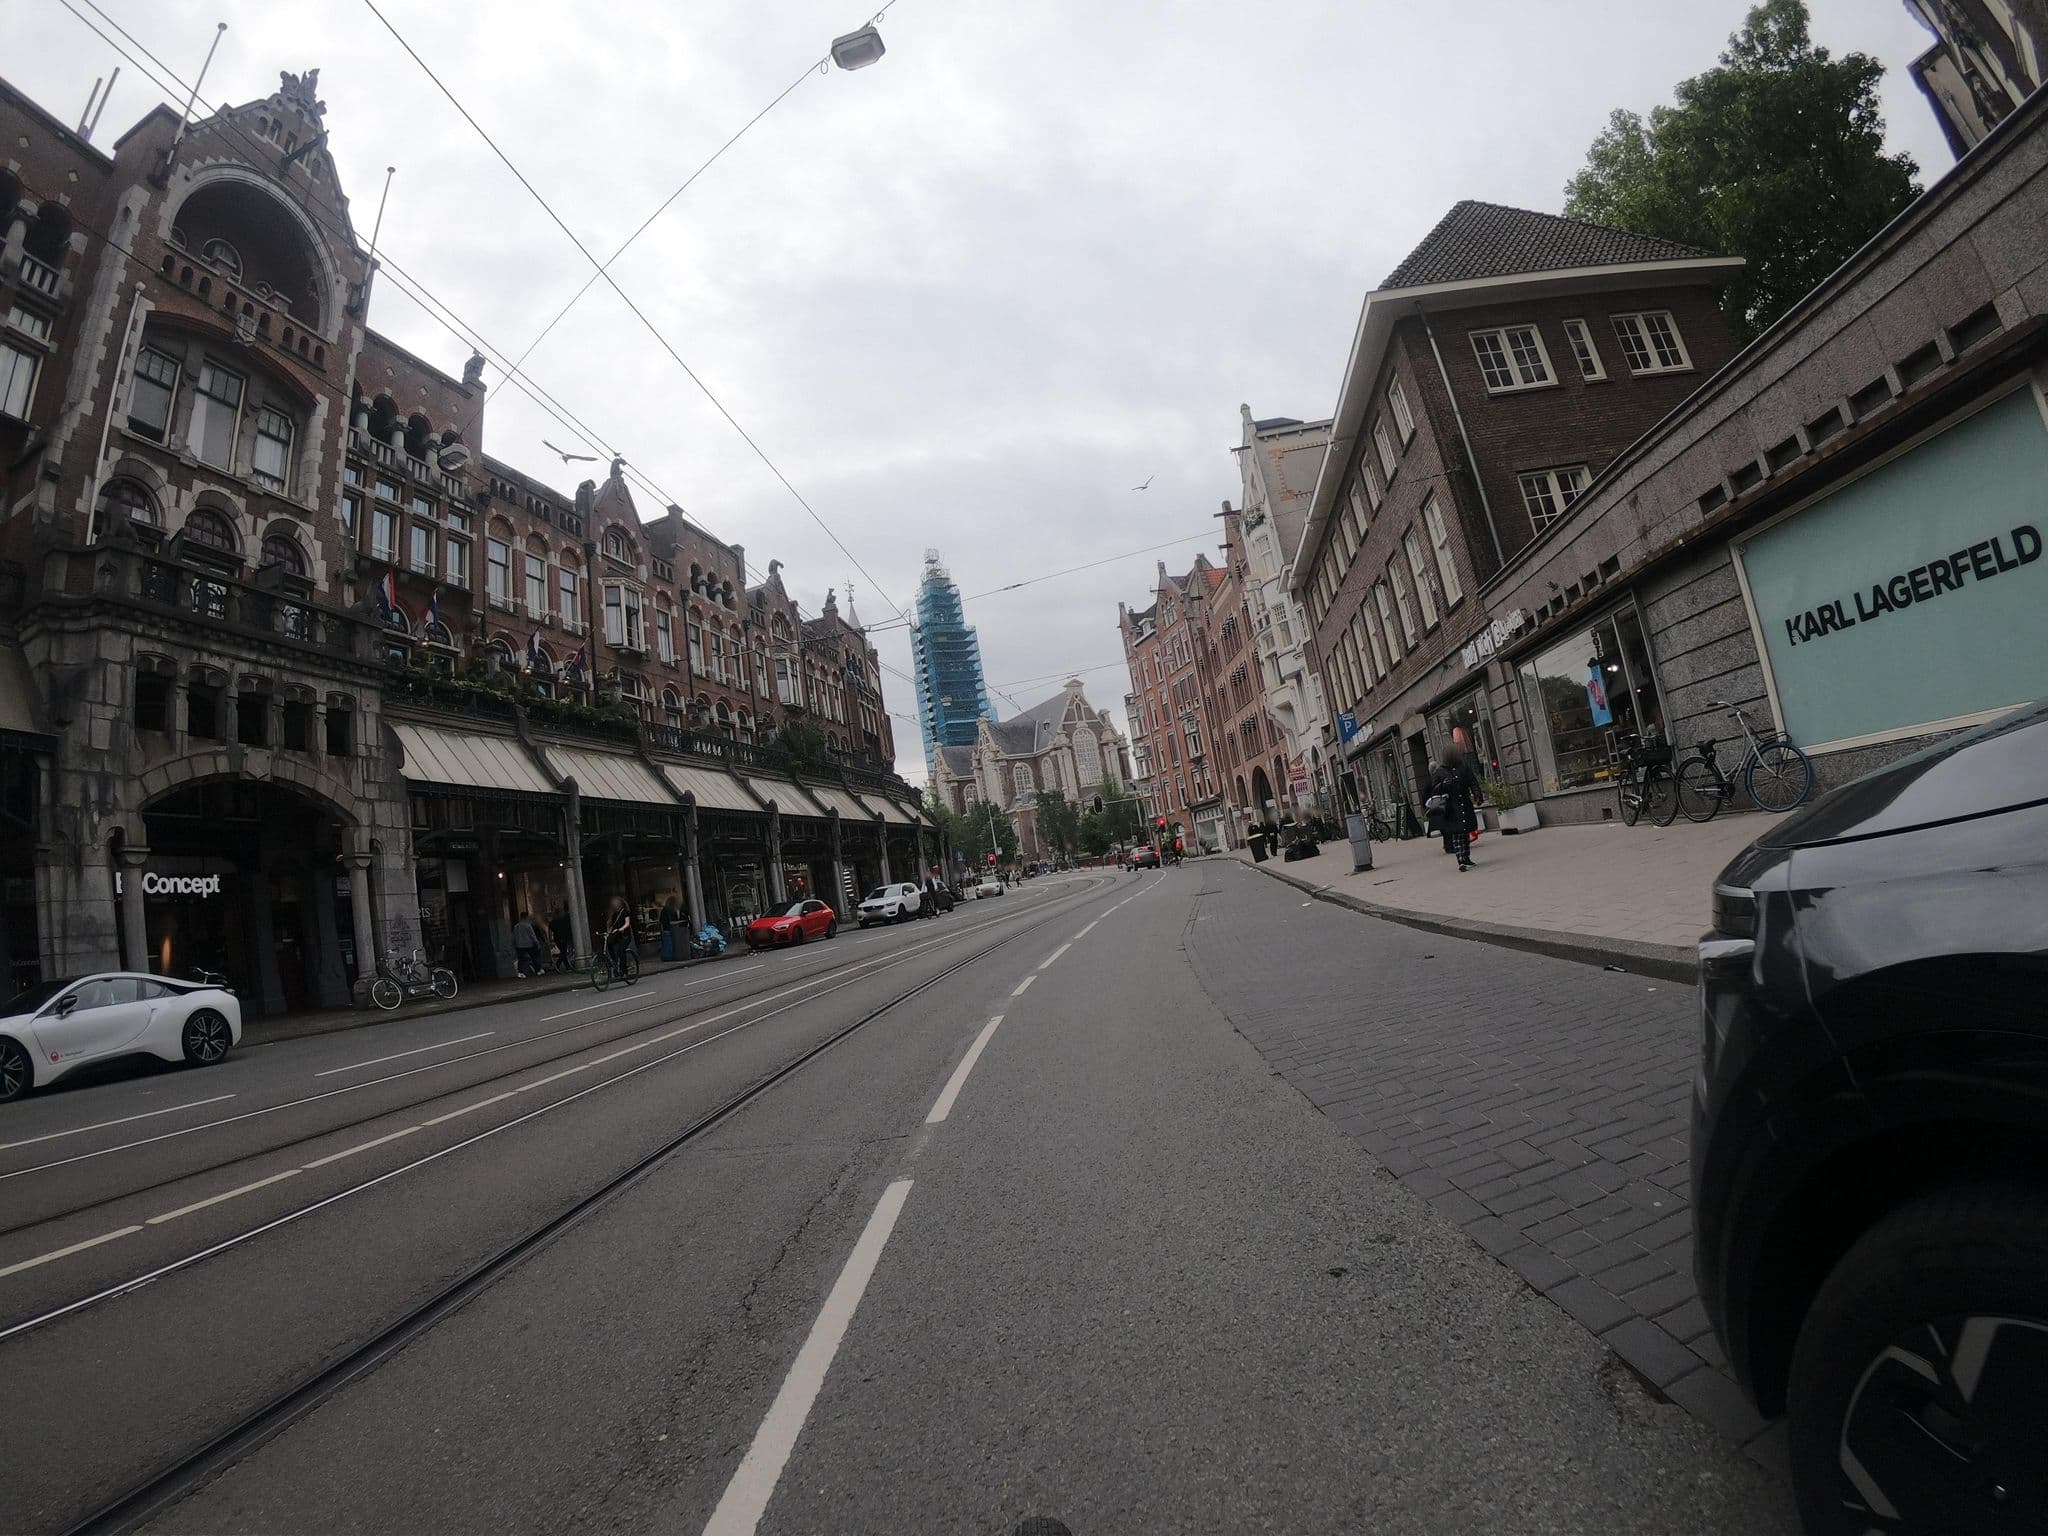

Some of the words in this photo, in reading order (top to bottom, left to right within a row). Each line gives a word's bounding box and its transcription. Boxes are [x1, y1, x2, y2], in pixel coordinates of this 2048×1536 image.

[1785, 599, 1855, 646] KARL
[1853, 525, 2043, 622] LAGERFELD
[1344, 721, 1352, 733] P
